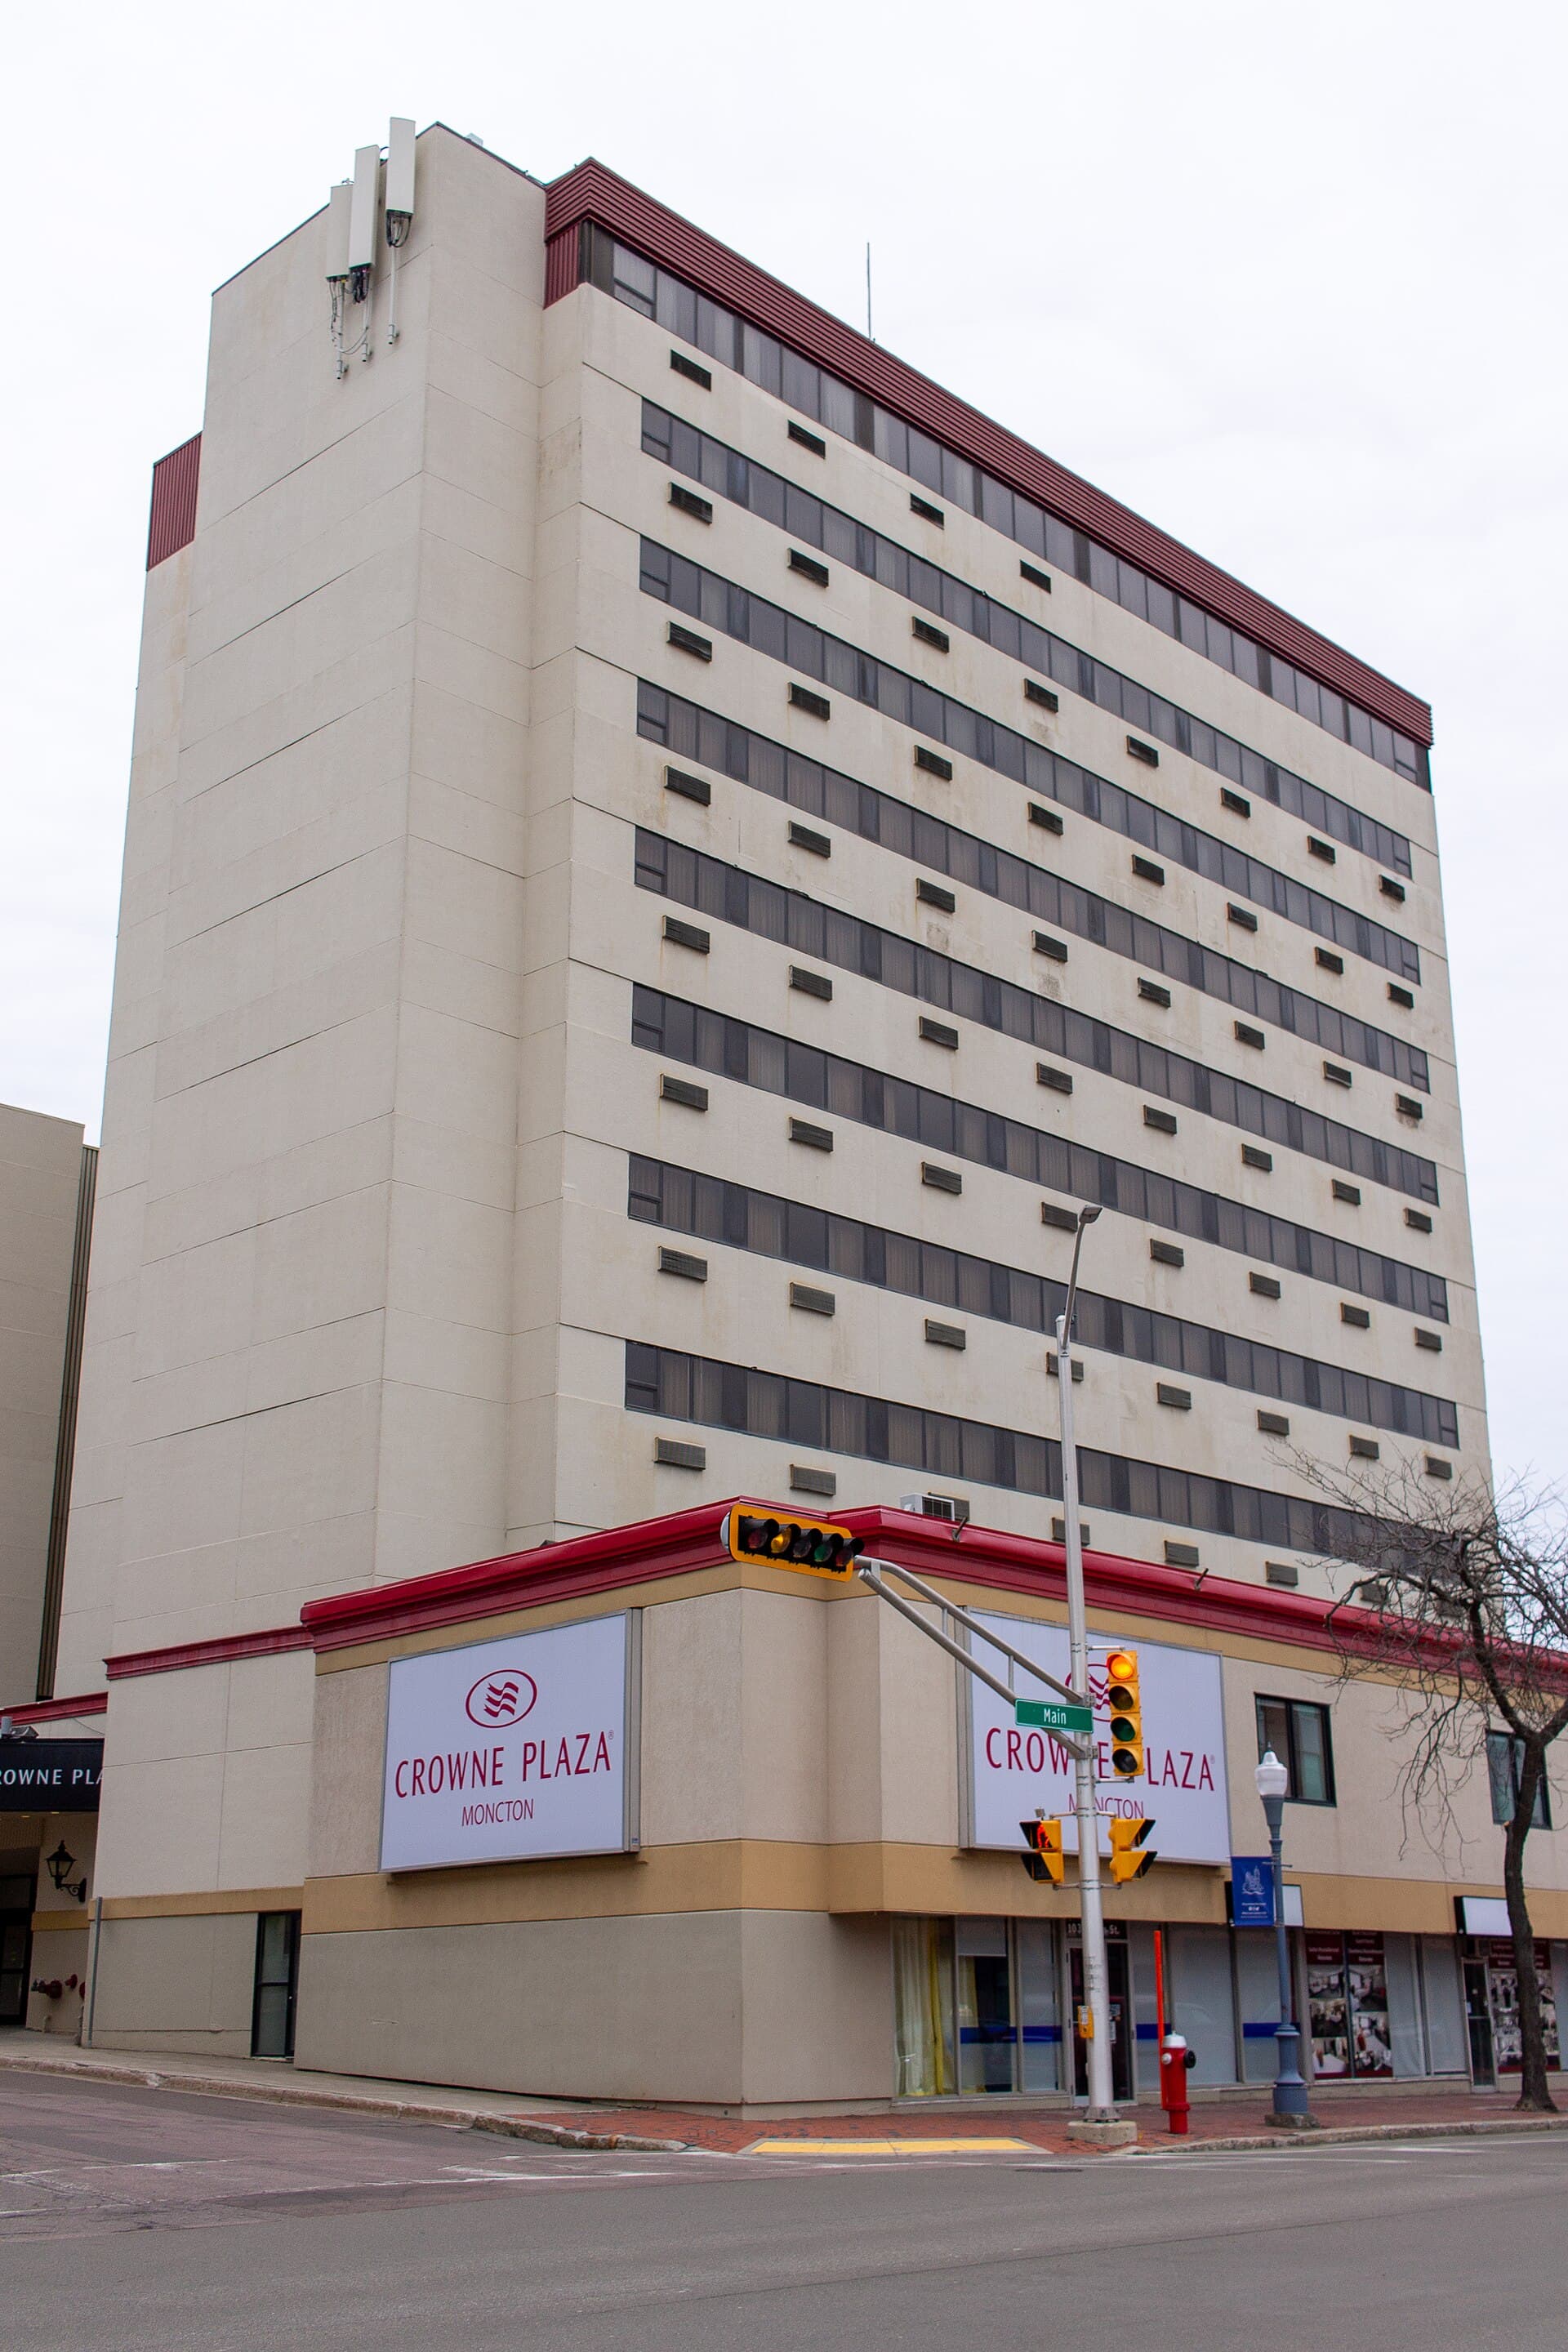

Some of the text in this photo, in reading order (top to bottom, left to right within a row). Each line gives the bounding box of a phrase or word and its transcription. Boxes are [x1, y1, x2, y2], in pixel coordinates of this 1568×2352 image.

[1044, 1708, 1067, 1725] Main
[394, 1731, 612, 1798] CROWNE PLAZA
[986, 1727, 1215, 1792] CROWE LAZA
[0, 1769, 63, 1785] OWNE
[461, 1798, 534, 1827] MONCTON
[1068, 1793, 1144, 1820] MNCTON
